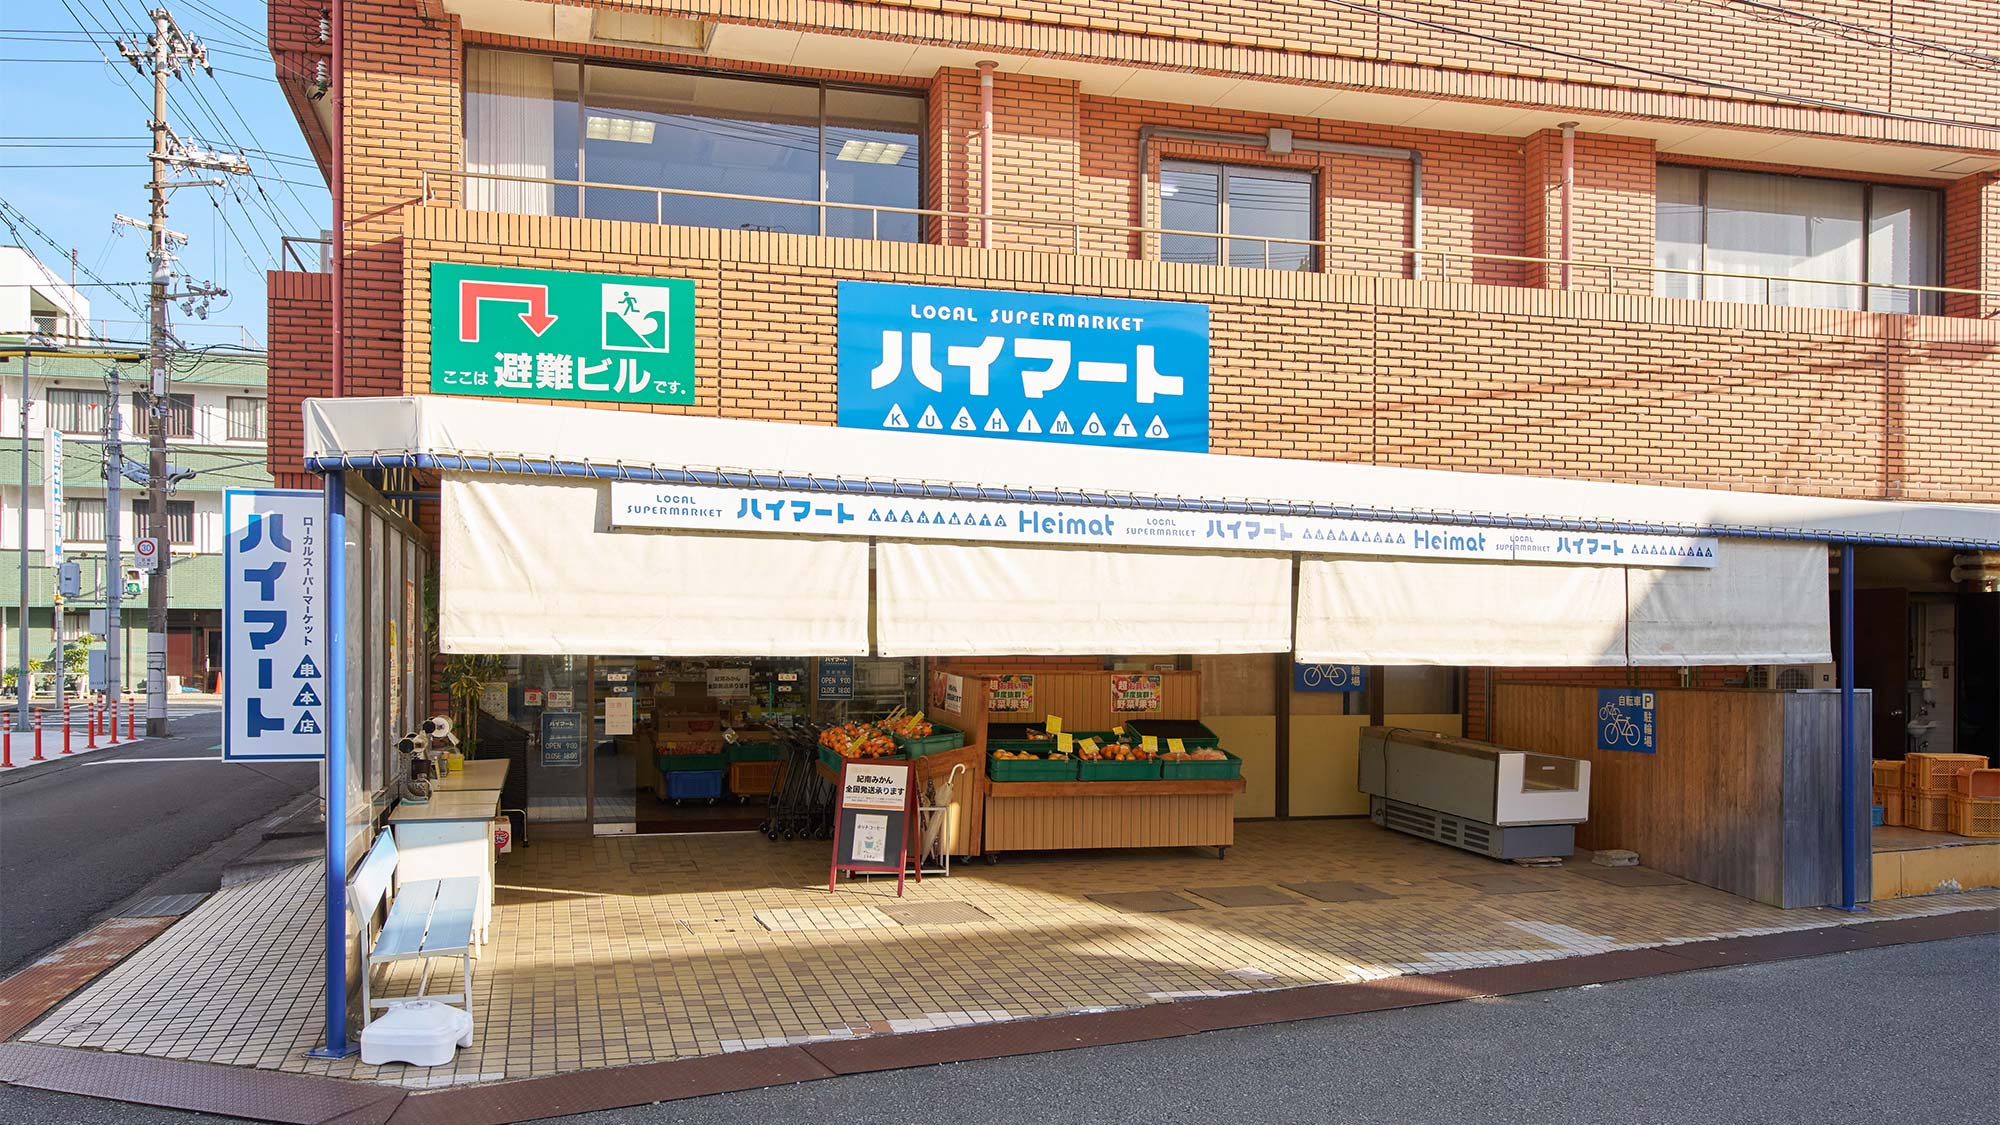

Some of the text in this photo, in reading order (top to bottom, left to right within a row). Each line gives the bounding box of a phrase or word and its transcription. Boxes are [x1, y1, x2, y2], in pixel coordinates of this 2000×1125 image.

[911, 304, 1144, 332] LOCAL SUPERMARKET
[871, 330, 1184, 404] ハイマート
[890, 412, 1163, 437] KUSHIMOTO
[656, 494, 696, 505] LOCAL
[737, 497, 855, 524] ハイマート
[627, 505, 723, 518] SUPERMARKET
[870, 509, 1005, 527] KUSHIMOTO
[1147, 517, 1176, 527] LOCAL
[1019, 510, 1115, 536] Heimat
[1126, 527, 1196, 537] SUPERMARKET
[1206, 519, 1293, 541] ハイマート
[141, 543, 152, 552] 30
[1414, 529, 1486, 551] Heimat
[1510, 535, 1533, 543] LOCAL
[1556, 537, 1624, 556] ハイマート
[302, 516, 315, 647] ローカルスーパーマーケット
[239, 514, 292, 738] ハイマート
[299, 663, 315, 733] 串本店
[1618, 695, 1641, 706] 自転車
[1643, 711, 1652, 747] 駐輪場
[545, 742, 561, 750] OPEN
